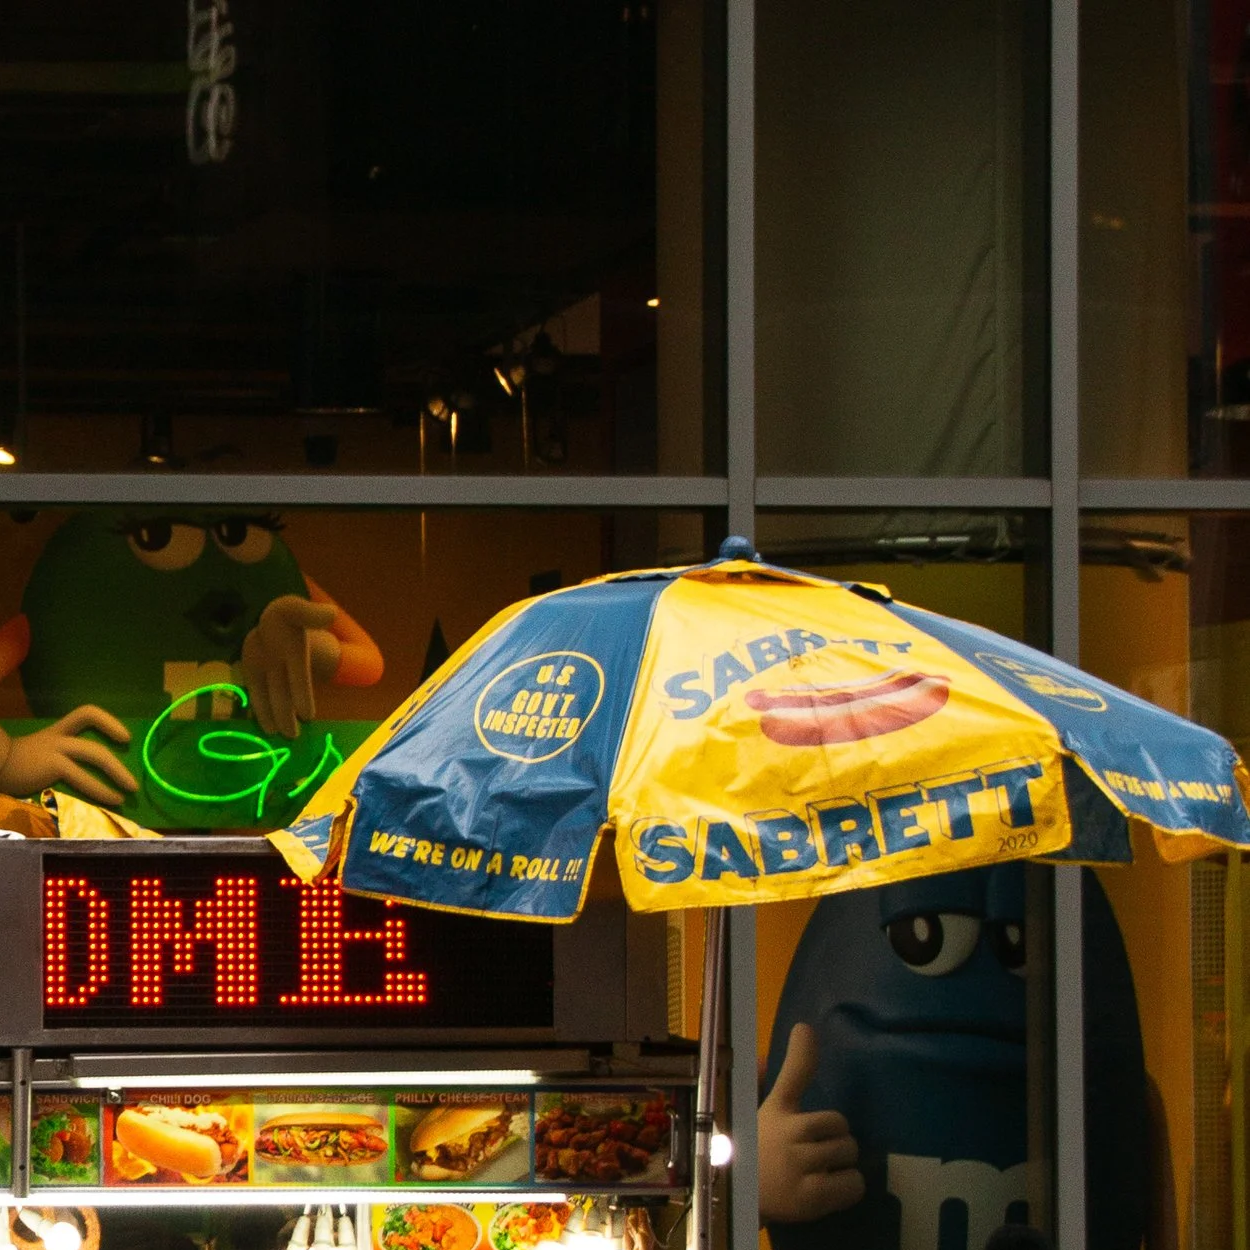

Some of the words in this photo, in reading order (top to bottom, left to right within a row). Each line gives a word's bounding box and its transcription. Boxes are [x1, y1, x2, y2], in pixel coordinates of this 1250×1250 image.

[536, 664, 576, 686] U.S.
[511, 692, 575, 717] GOV'T
[482, 709, 582, 740] INSPECTED
[629, 756, 1044, 884] SABRETT
[997, 831, 1039, 853] 2020
[368, 830, 445, 865] WE'RE
[450, 845, 483, 872] ON
[487, 851, 504, 874] A
[510, 854, 560, 881] ROLL
[36, 1093, 100, 1105] SANDWICH
[149, 1093, 181, 1104] CHILI
[184, 1094, 212, 1105] DOG
[395, 1093, 435, 1104] PHILLY
[489, 1092, 530, 1104] STEAK
